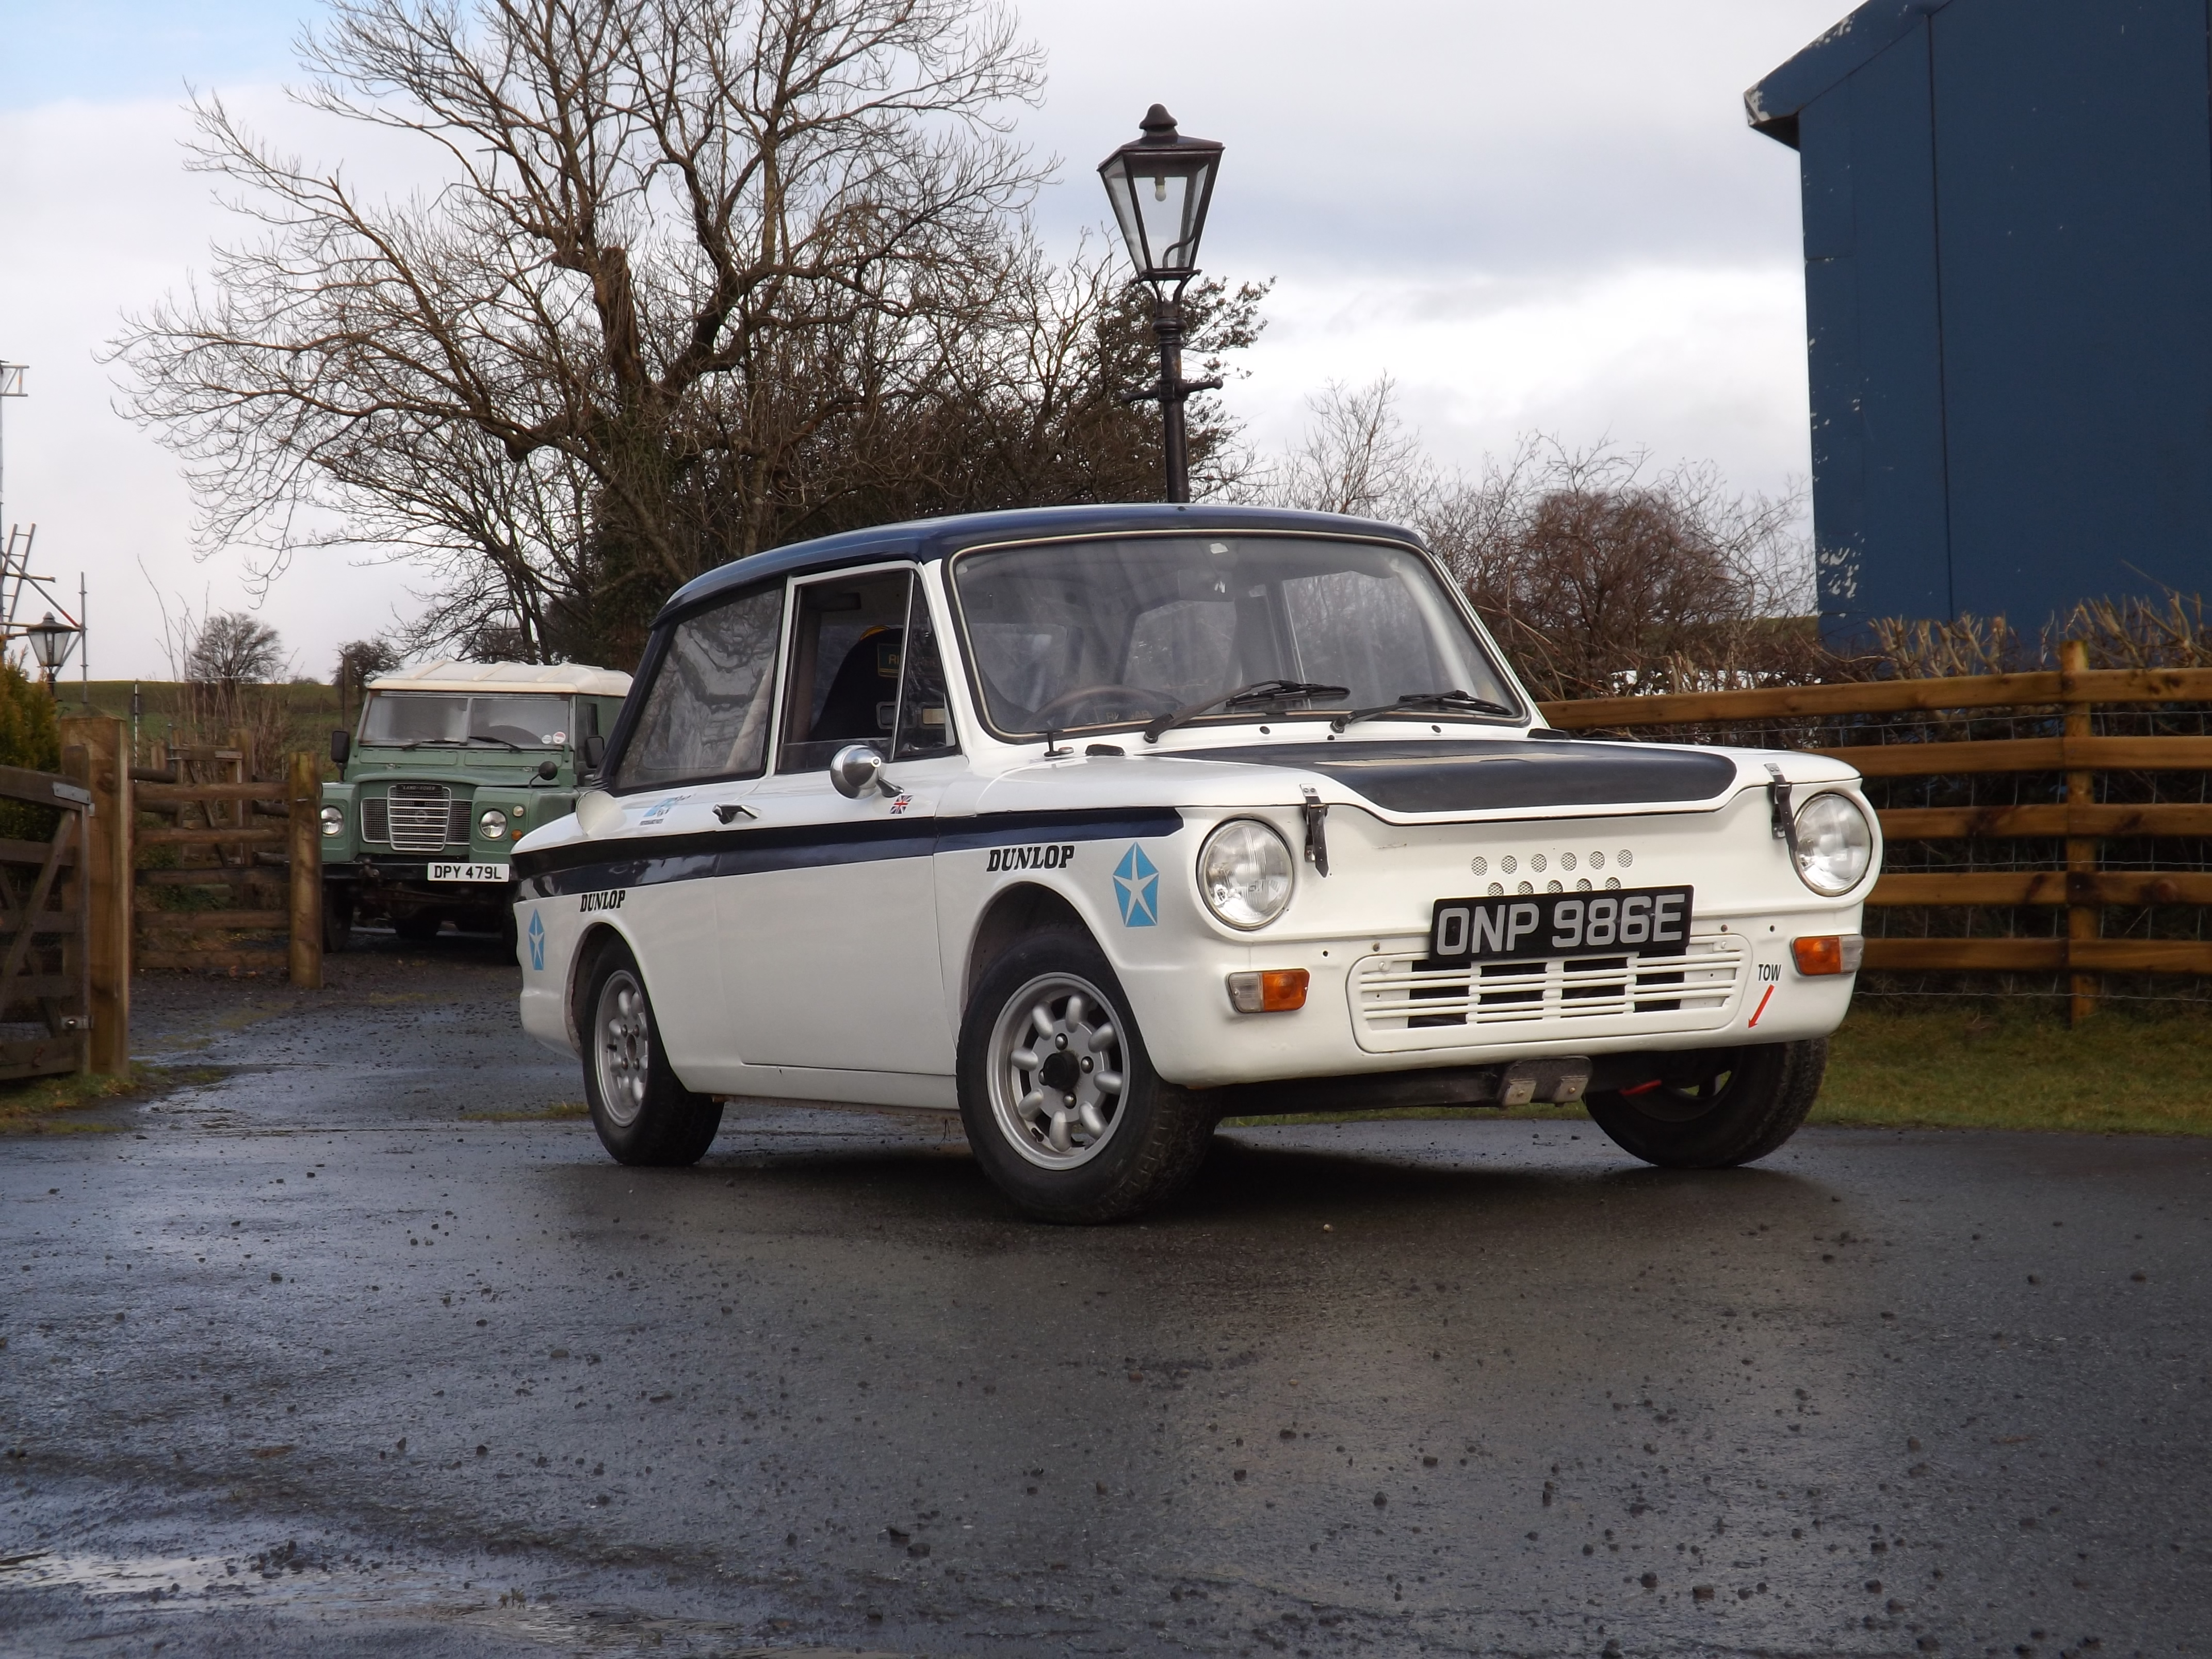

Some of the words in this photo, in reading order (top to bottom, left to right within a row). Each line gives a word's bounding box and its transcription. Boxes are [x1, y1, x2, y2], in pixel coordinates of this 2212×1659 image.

[986, 845, 1075, 872] DUNLOP
[434, 865, 461, 878] DPY
[465, 866, 502, 879] 479L
[579, 890, 626, 912] DUNLOP
[1437, 903, 1539, 955] ONP
[1552, 893, 1685, 948] 986E
[1758, 964, 1782, 981] TOW
